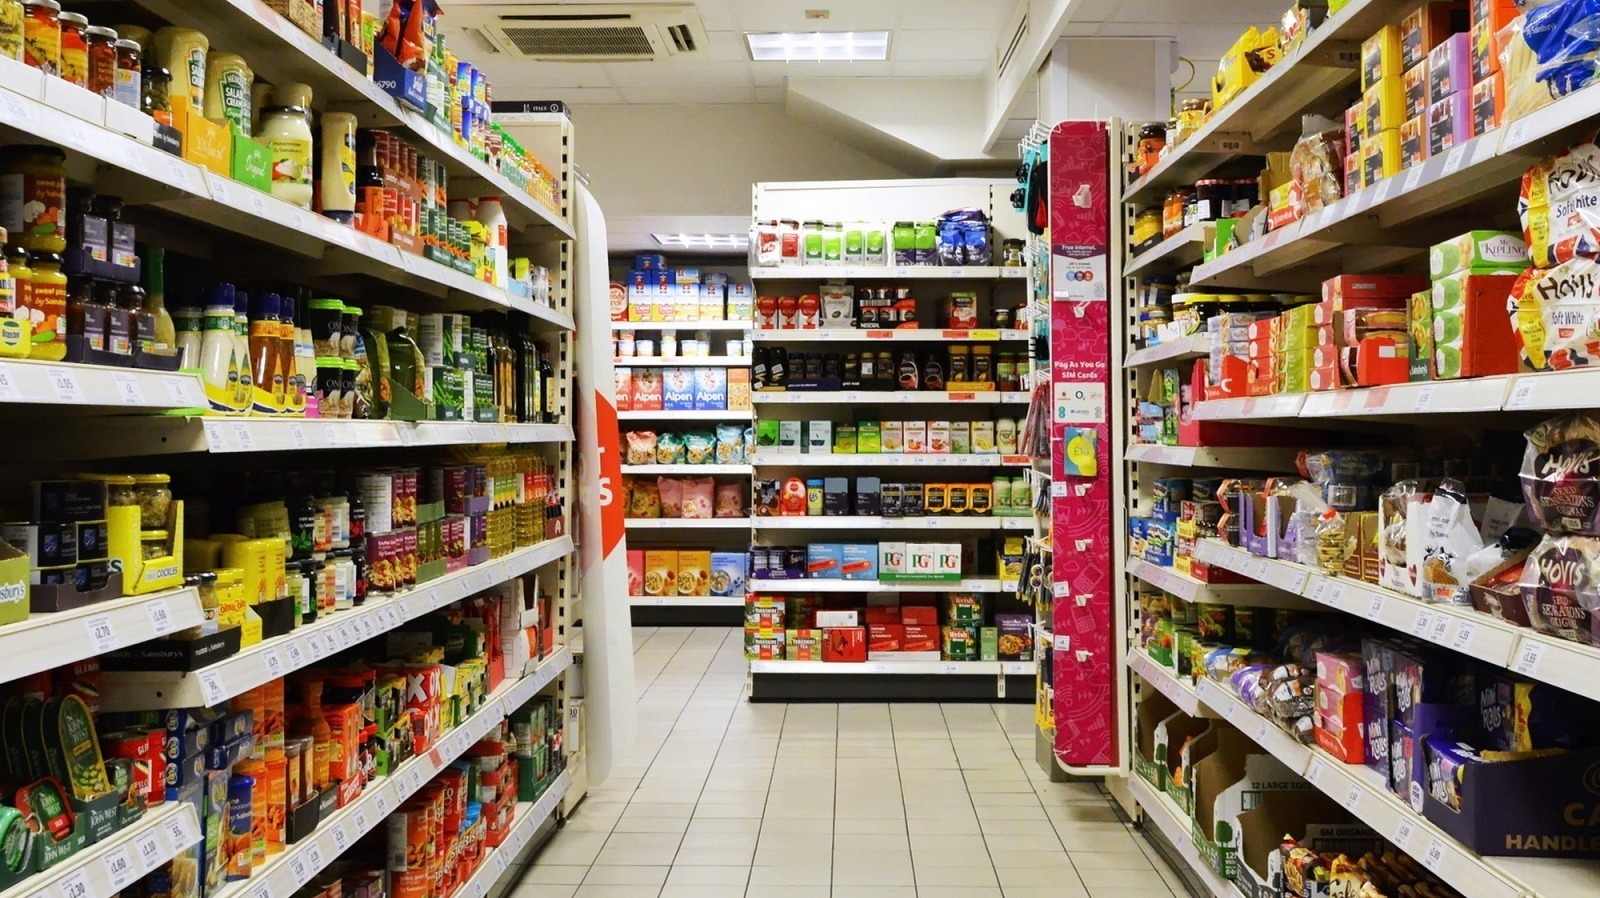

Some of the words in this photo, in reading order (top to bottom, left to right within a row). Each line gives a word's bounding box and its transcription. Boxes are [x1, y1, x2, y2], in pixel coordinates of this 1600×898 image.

[1573, 195, 1598, 209] hite
[1054, 361, 1069, 369] Pay
[1077, 371, 1098, 379] Cards
[634, 392, 662, 402] Alpen
[665, 392, 693, 402] Alpen
[696, 392, 724, 402] Alpen
[884, 552, 900, 567] PG
[912, 554, 928, 568] PG
[940, 554, 956, 568] PG
